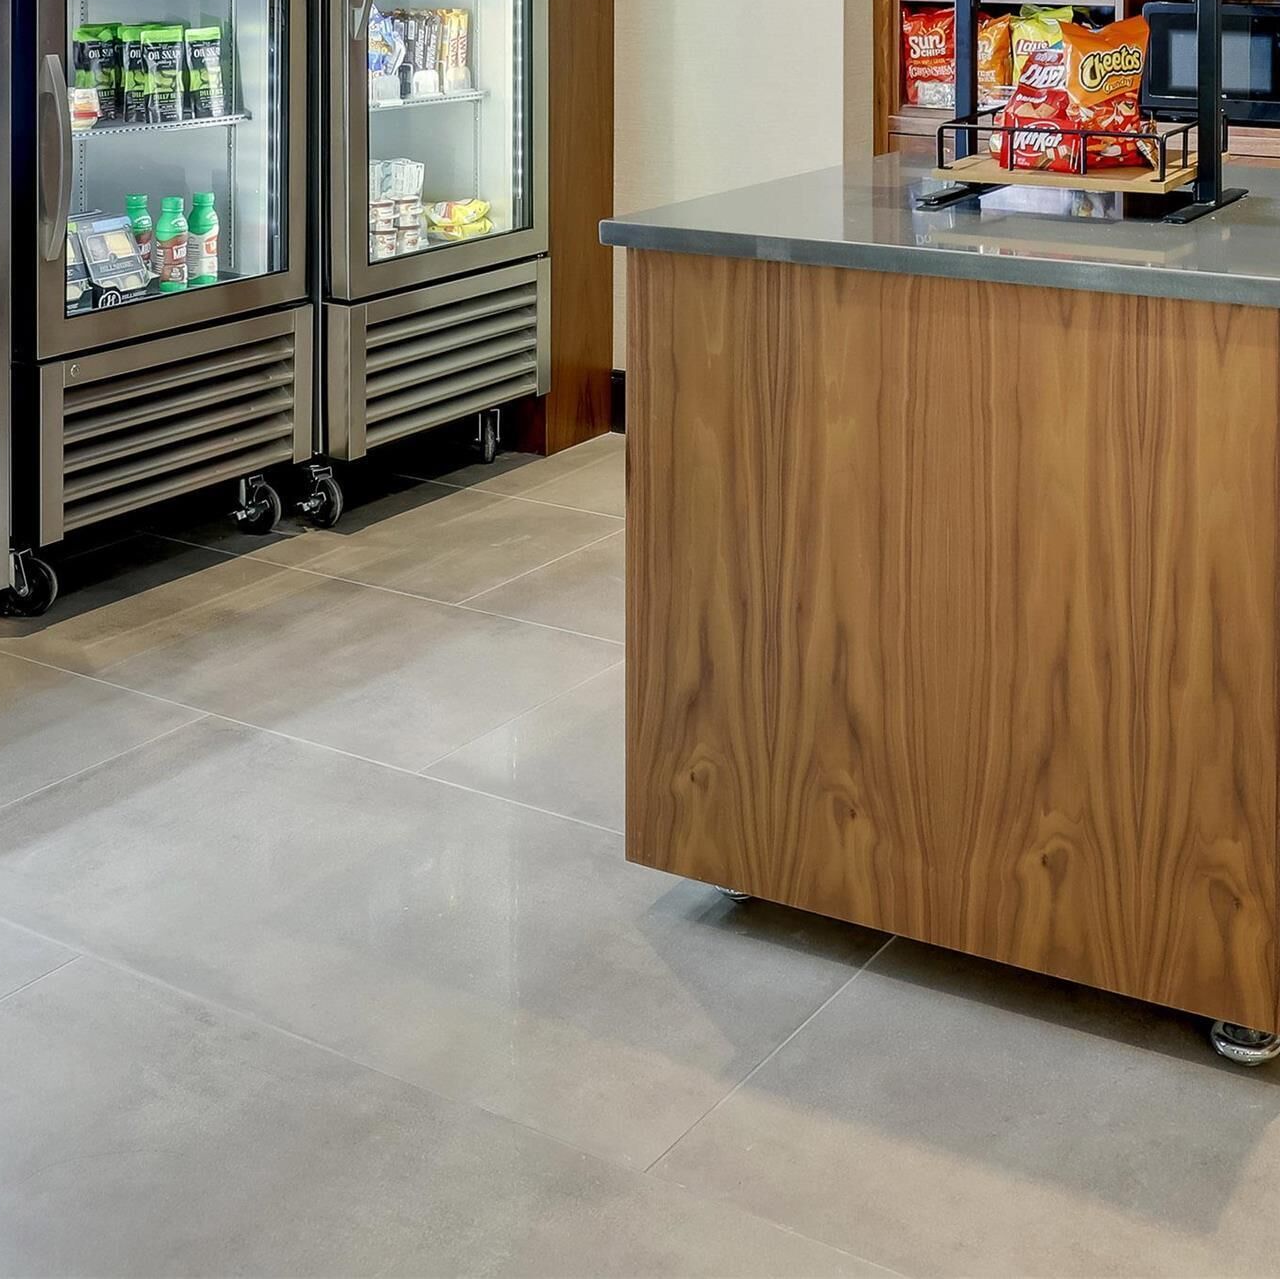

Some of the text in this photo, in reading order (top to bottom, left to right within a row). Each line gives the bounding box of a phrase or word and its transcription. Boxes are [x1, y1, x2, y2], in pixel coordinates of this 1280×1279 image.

[909, 34, 946, 58] Sun
[148, 51, 160, 60] OH
[194, 48, 205, 57] OH
[920, 48, 946, 57] CHIPS
[1081, 45, 1142, 88] Cheetos
